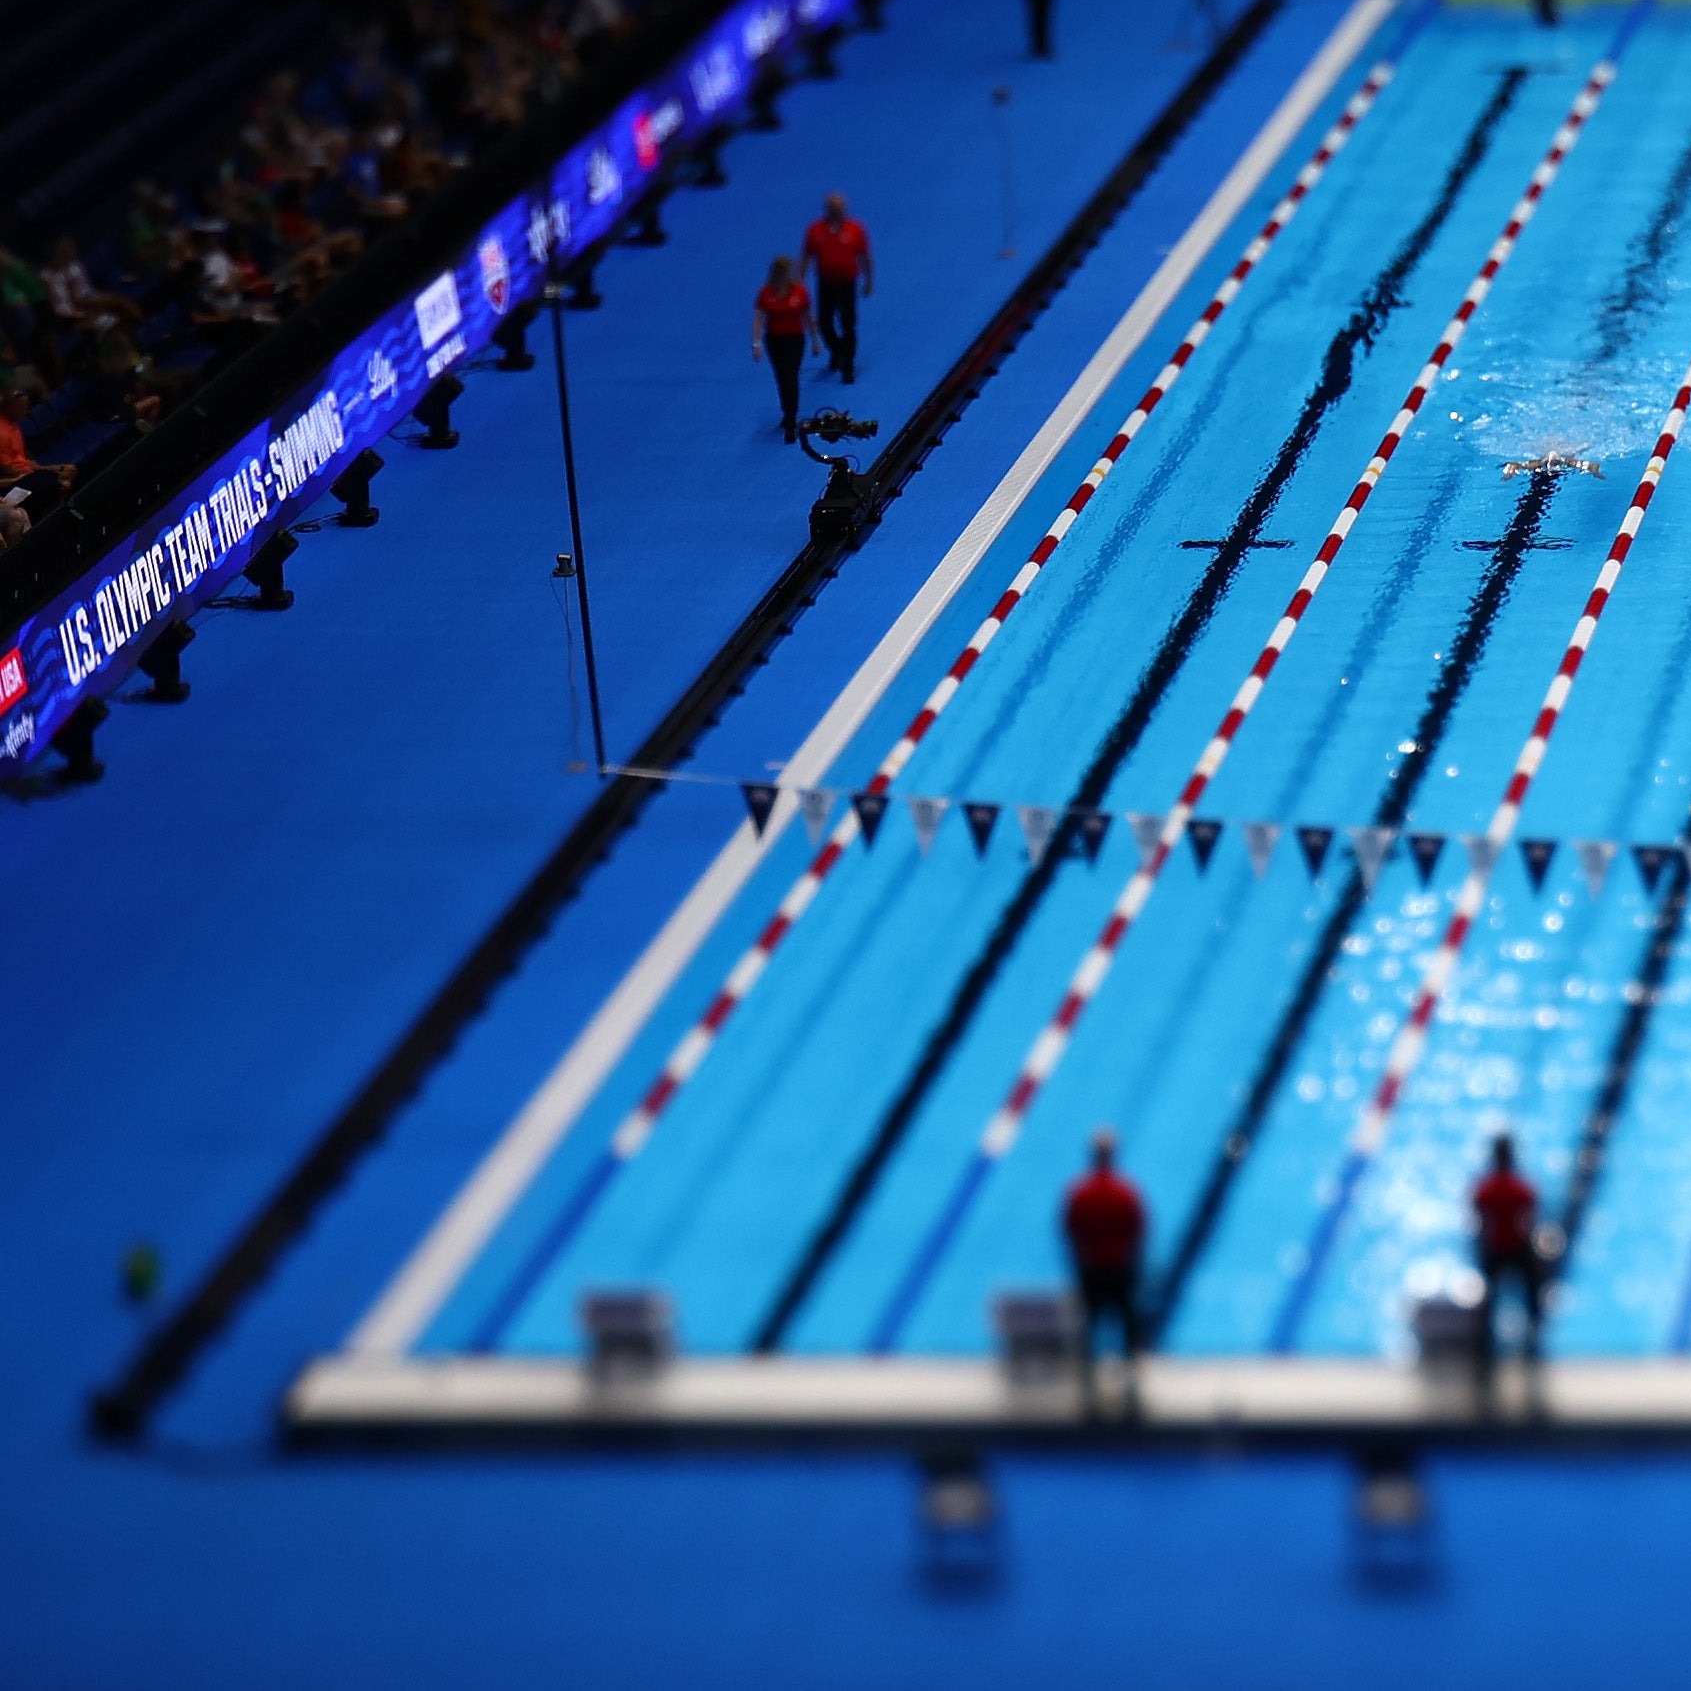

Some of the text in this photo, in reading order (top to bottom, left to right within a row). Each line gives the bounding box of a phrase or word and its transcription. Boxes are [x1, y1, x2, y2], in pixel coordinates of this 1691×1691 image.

[59, 606, 102, 687] U.S.
[95, 543, 171, 656] OLYMPIC
[164, 504, 216, 594] TEAM
